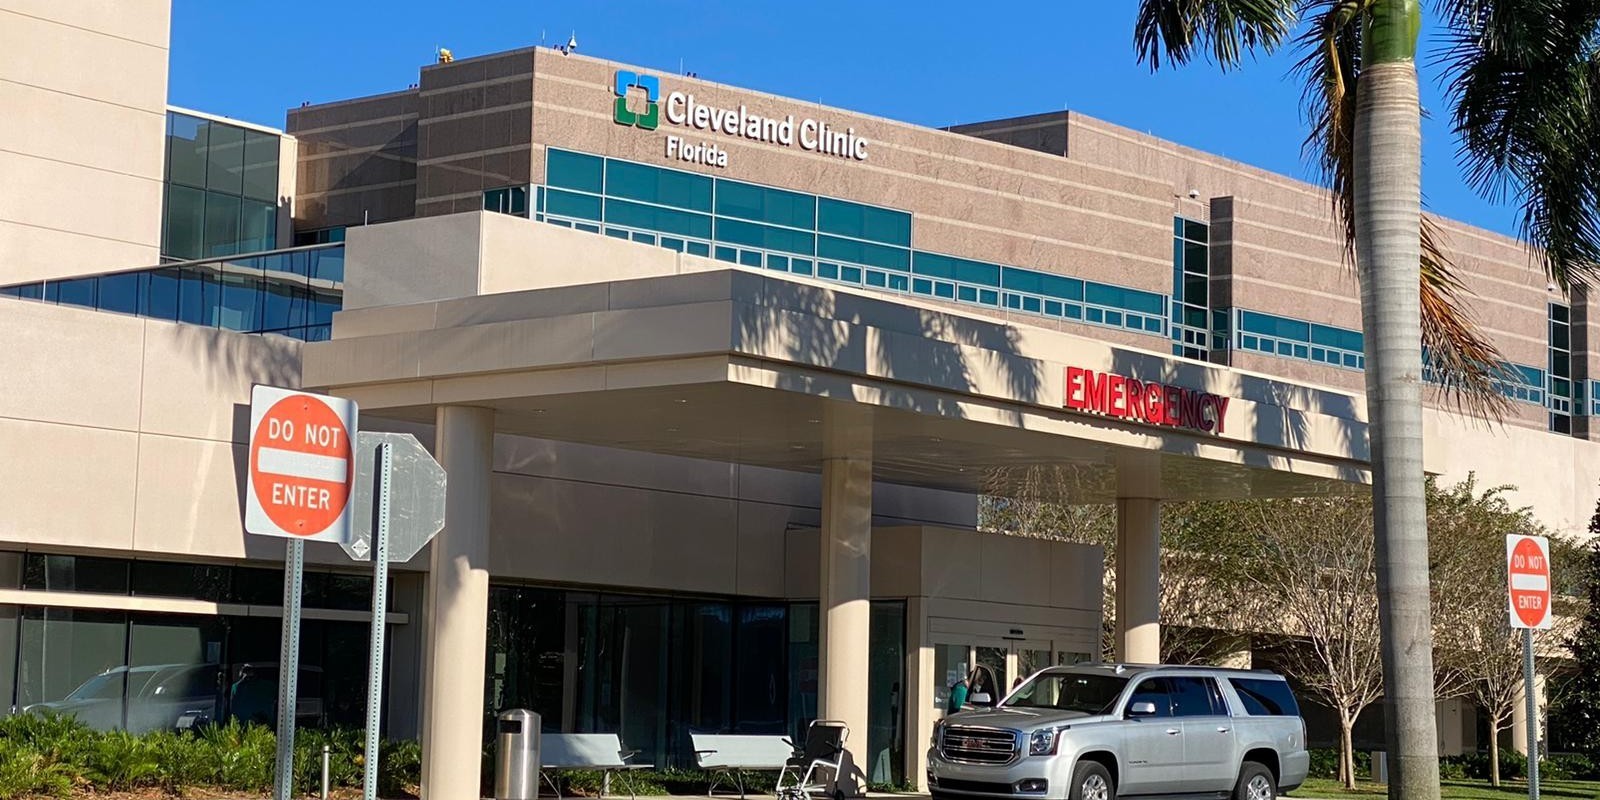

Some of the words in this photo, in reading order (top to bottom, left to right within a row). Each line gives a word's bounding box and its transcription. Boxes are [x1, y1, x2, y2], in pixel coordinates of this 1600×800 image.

[666, 91, 793, 146] Cleveland
[800, 118, 868, 160] Clinic
[665, 135, 728, 167] Florida
[1065, 366, 1230, 433] EMERGENCY
[268, 418, 294, 442] DO
[305, 424, 341, 449] NOT
[272, 483, 330, 510] ENTER
[1514, 554, 1525, 569] DO
[1528, 555, 1543, 570] NOT
[1518, 594, 1542, 610] ENTER
